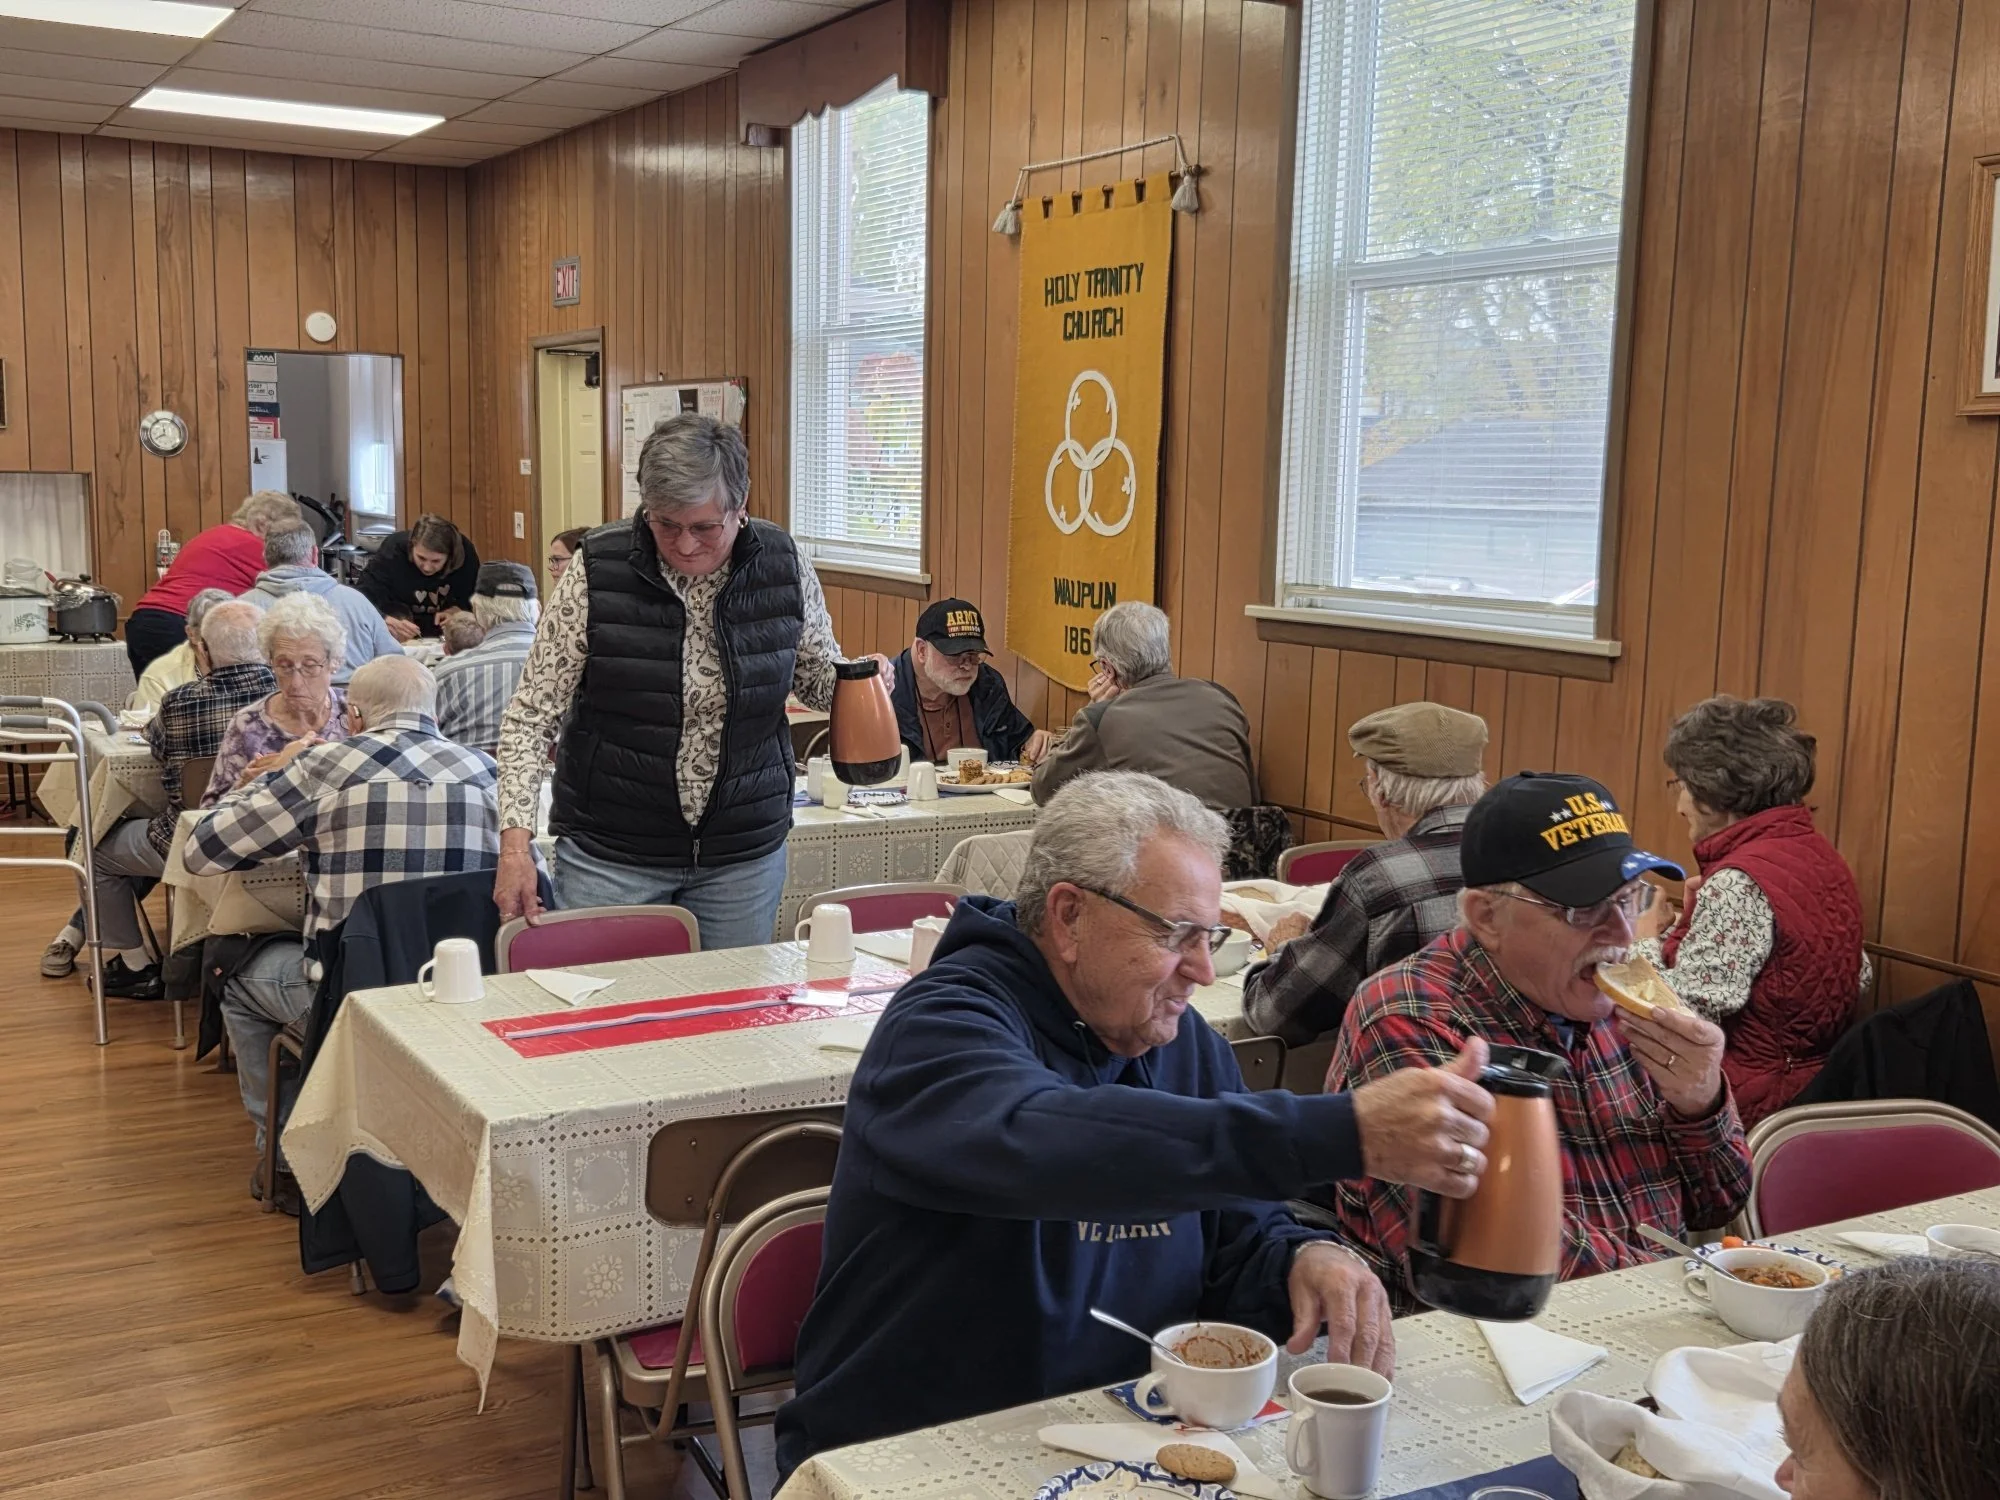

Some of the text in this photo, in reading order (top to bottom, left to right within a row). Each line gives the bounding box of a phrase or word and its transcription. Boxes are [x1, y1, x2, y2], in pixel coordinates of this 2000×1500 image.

[557, 265, 577, 298] EXIT
[1044, 262, 1144, 307] HOLY TRINITY
[1062, 307, 1124, 341] CHURCH
[1053, 577, 1117, 609] WAUPUN
[946, 610, 979, 626] ARMY
[1064, 625, 1092, 655] 186
